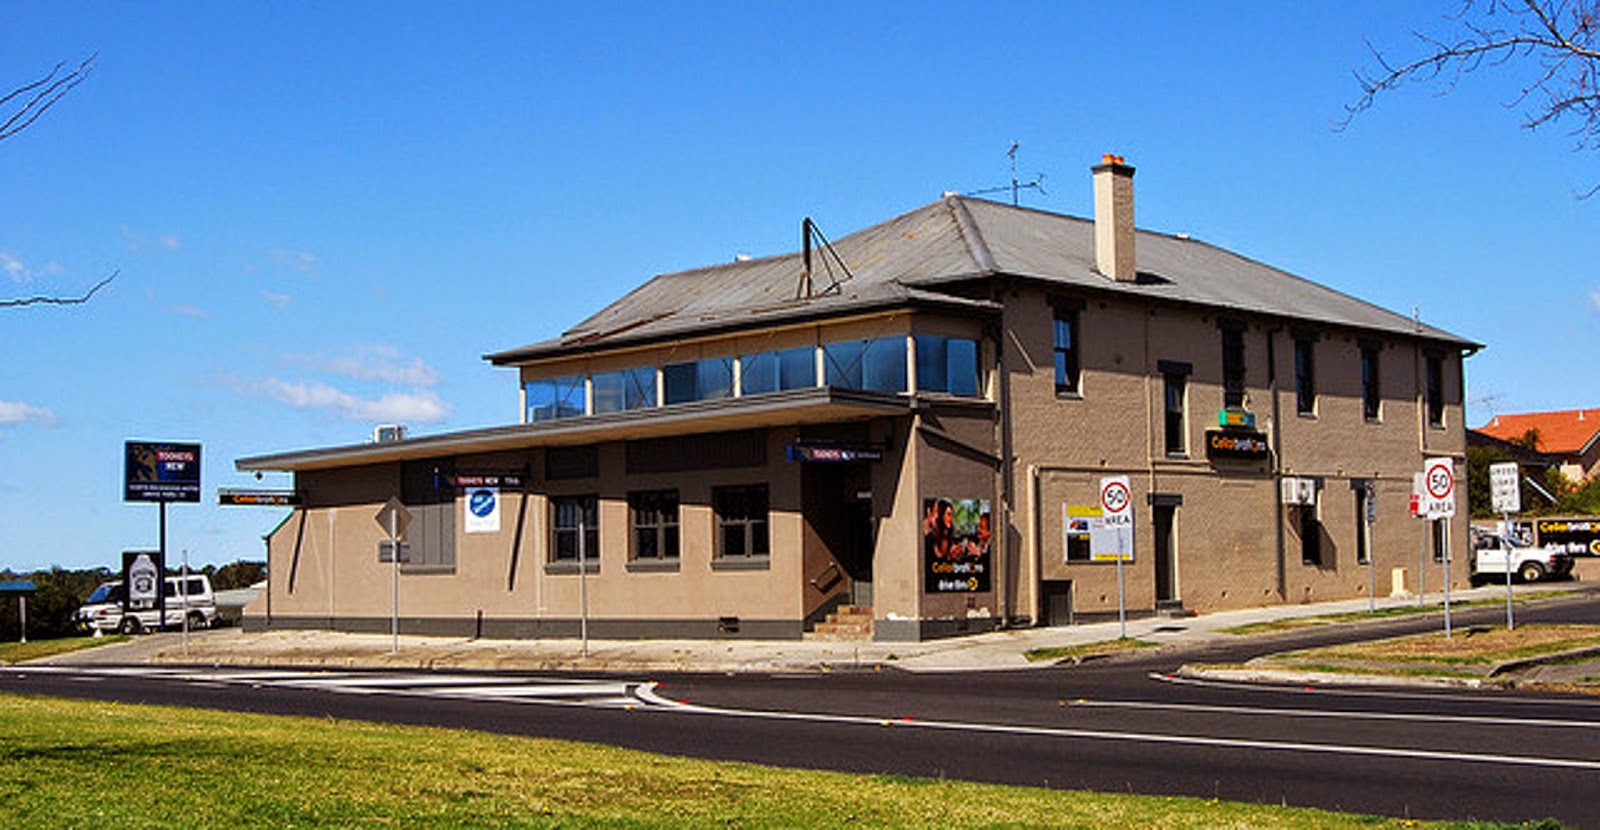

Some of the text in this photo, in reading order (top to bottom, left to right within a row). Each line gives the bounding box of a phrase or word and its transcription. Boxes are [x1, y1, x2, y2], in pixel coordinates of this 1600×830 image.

[158, 451, 194, 462] TOOHEYS
[165, 462, 186, 471] NEW
[1432, 474, 1448, 490] 50
[1107, 489, 1126, 505] 50
[1429, 502, 1453, 512] AREA
[1105, 515, 1130, 525] AREA
